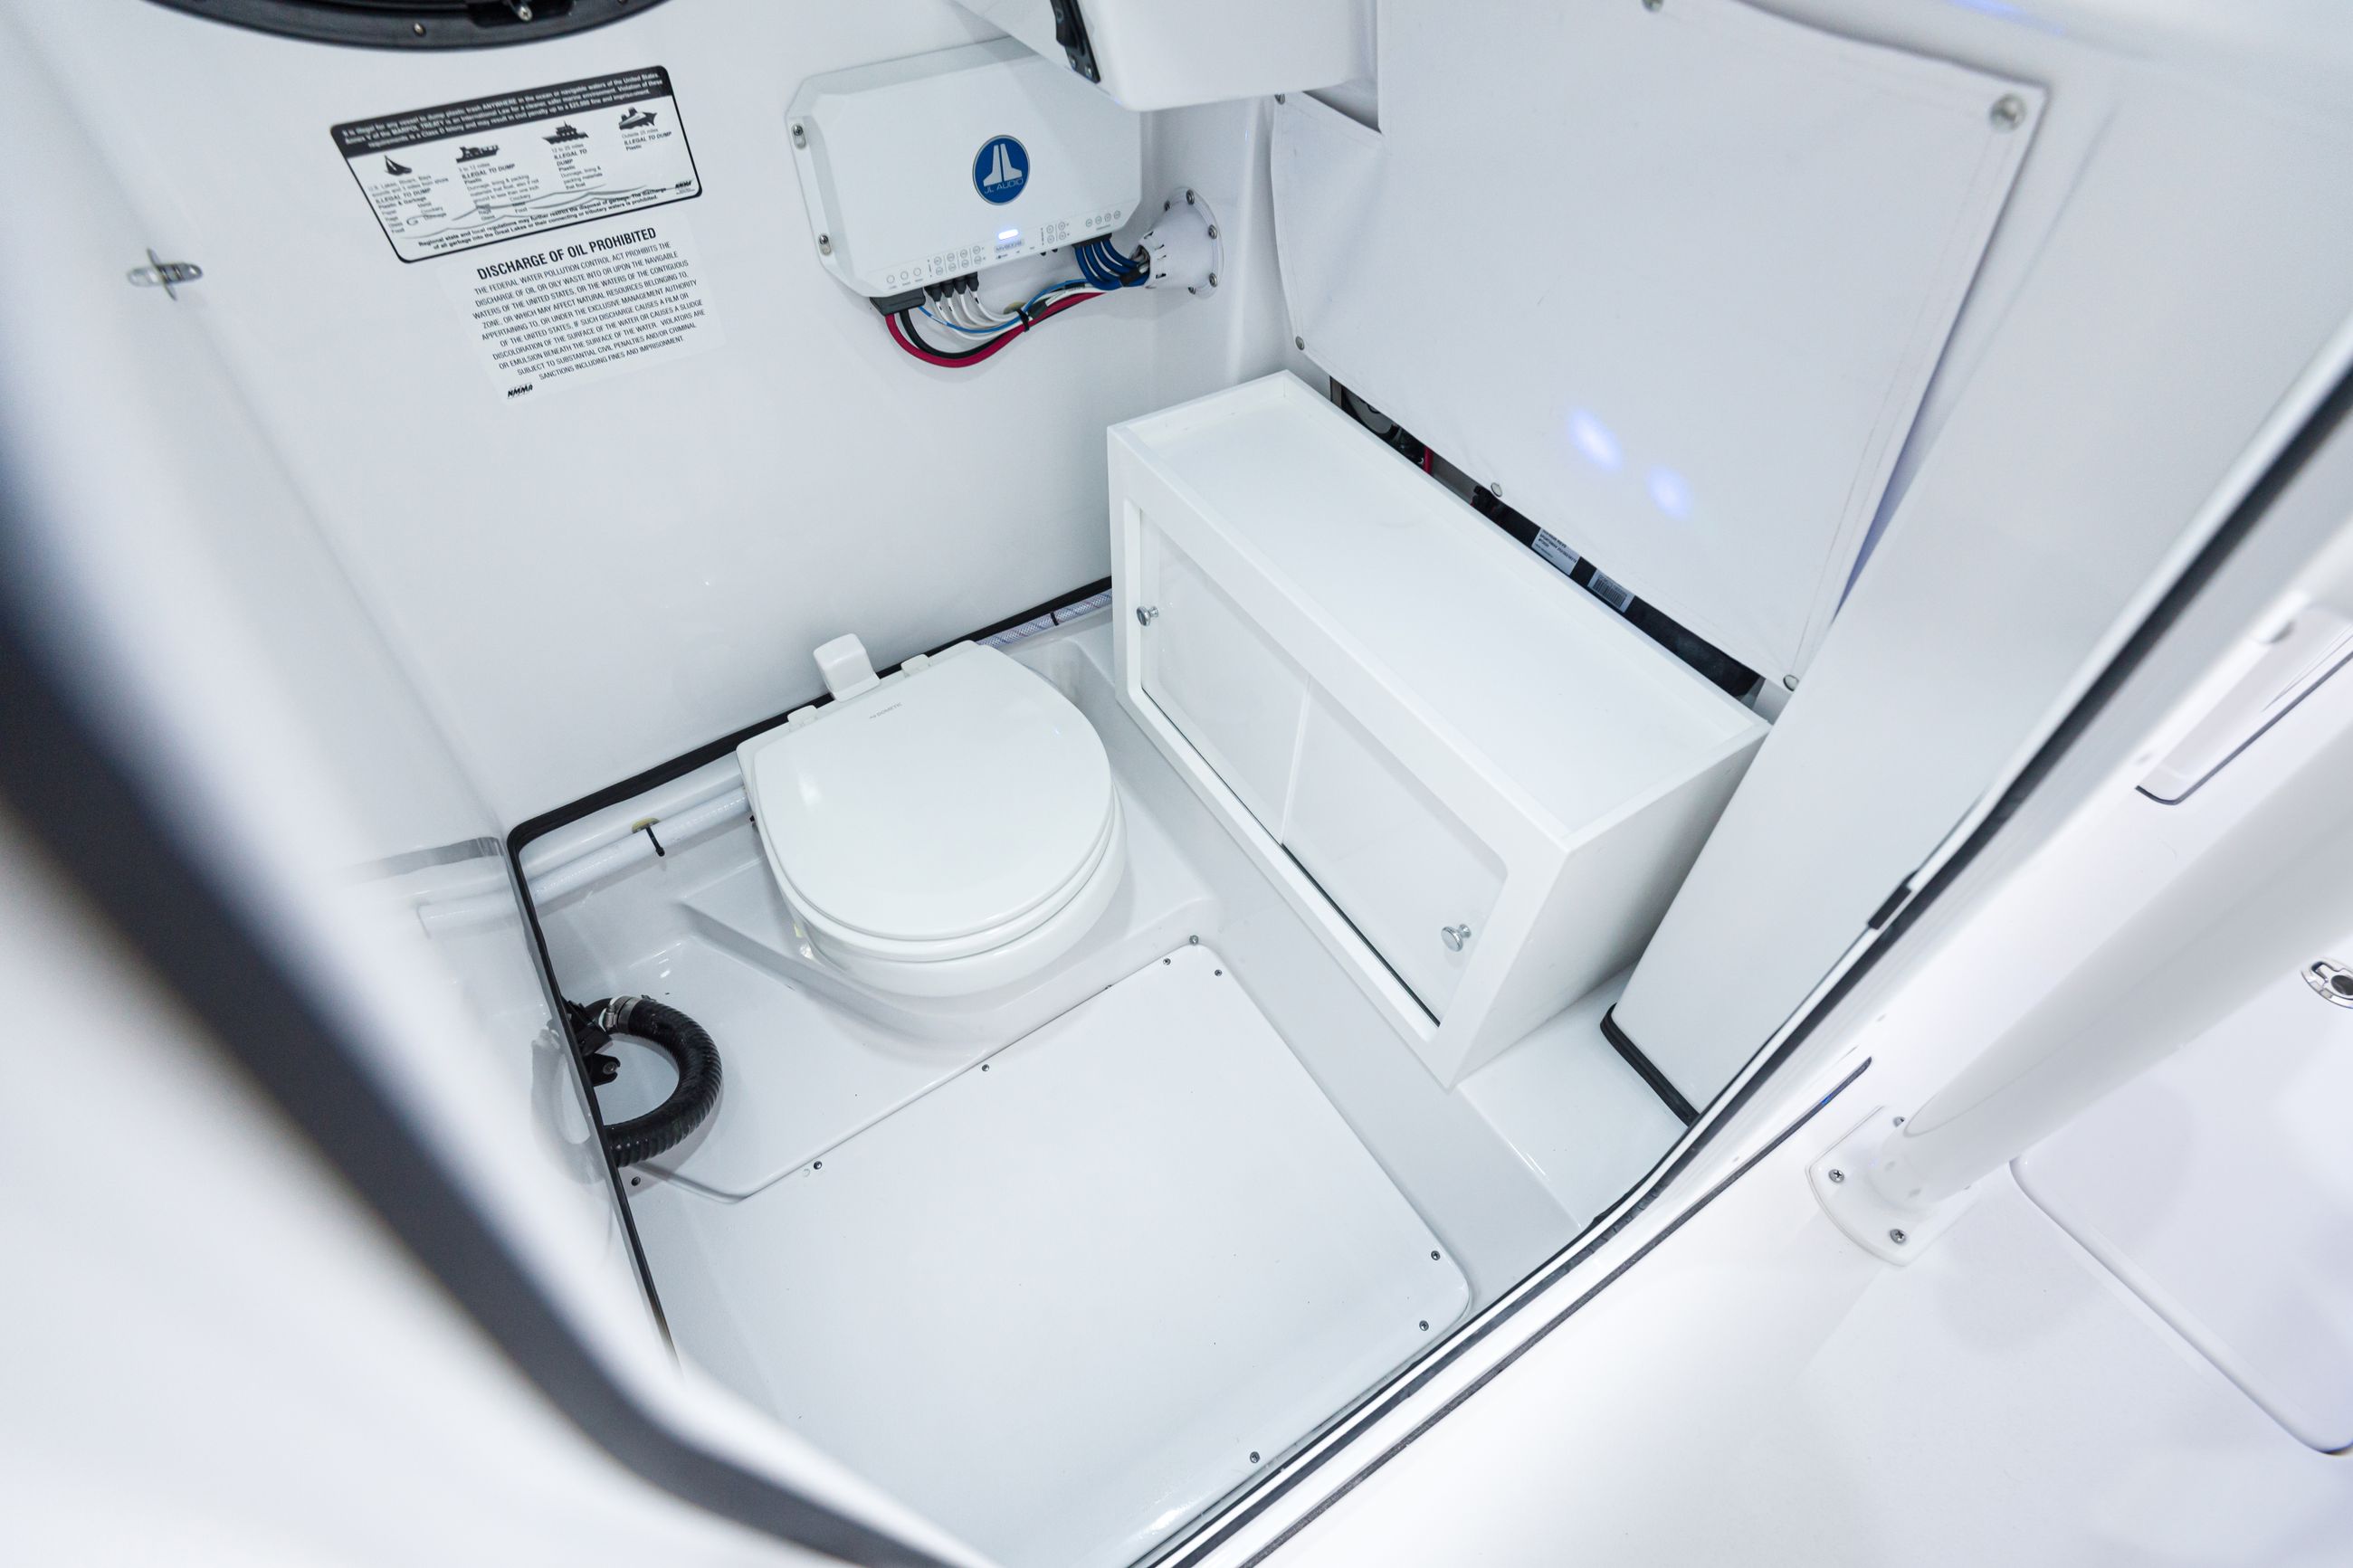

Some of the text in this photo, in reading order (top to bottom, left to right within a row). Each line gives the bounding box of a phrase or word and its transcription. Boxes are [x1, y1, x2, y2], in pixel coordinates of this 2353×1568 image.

[553, 151, 576, 159] ILLEGAL
[624, 137, 646, 145] ILLEGAL
[375, 195, 400, 203] ILLEGAL
[412, 187, 432, 195] DUMP
[461, 170, 486, 178] ILLEGAL
[996, 178, 1024, 191] AUDIO
[474, 241, 670, 295] THE FEDERAL WATER POLLUTION CONTROL ACT PROHIBITS THE
[474, 251, 677, 307] DISCHARGE OF OIL OR OILY WASTE INTO OR UPON THE NAVIGABLE
[476, 226, 656, 279] DISCHARGE OF OIL PROHIBITED
[472, 307, 501, 319] WATERS
[500, 304, 510, 312] OF
[511, 300, 525, 309] THE
[525, 294, 550, 306] UNITED
[576, 285, 586, 293] OR
[587, 281, 600, 290] THE
[600, 274, 626, 287] WATERS
[626, 272, 635, 280] OF
[636, 269, 648, 278] THE
[649, 259, 689, 275] CONTIGUOUS
[480, 322, 529, 340] APPERTAINING
[539, 317, 550, 325] OR
[550, 310, 574, 322] UNDER
[574, 308, 586, 316] THE
[586, 299, 620, 313] EXCLUSIVE
[620, 288, 663, 304] MANAGEMENT
[663, 279, 697, 293] AUTHORITY
[502, 315, 513, 323] OR
[513, 309, 537, 320] WHICH
[537, 305, 552, 315] MAY
[552, 299, 576, 310] AFFECT
[576, 291, 605, 304] NATURAL
[605, 281, 643, 297] RESOURCES
[643, 273, 678, 288] BELONGING
[491, 341, 543, 360] DISCOLORATION
[543, 338, 552, 347] OF
[553, 335, 566, 344] THE
[566, 328, 595, 340] SURFACE
[595, 325, 604, 333] OF
[605, 321, 616, 330] THE
[617, 316, 639, 327] WATER
[639, 313, 649, 321] OR
[649, 307, 673, 318] CAUSES
[679, 299, 702, 310] SLUDGE
[498, 361, 510, 369] OR
[509, 352, 543, 366] EMULSION
[542, 344, 572, 357] BENEATH
[572, 341, 585, 349] THE
[585, 333, 613, 346] SURFACE
[623, 328, 634, 336] THE
[660, 312, 692, 326] VIOLATORS
[692, 309, 704, 318] ARE
[499, 338, 509, 347] OF
[510, 335, 522, 344] THE
[522, 328, 548, 340] UNITED
[579, 315, 598, 326] SUCH
[597, 306, 634, 320] DISCHARGE
[634, 299, 659, 311] CAUSES
[664, 294, 679, 303] FILM
[679, 291, 689, 299] OR
[516, 321, 695, 375] SUBJECT TO SUBSTANTIAL CIVIL PENALTIES AND/OR CRIMINAL
[538, 335, 682, 380] SANCTIONS INCLUDING FINES AND IMPRISONMENT
[507, 383, 534, 398] NMMA
